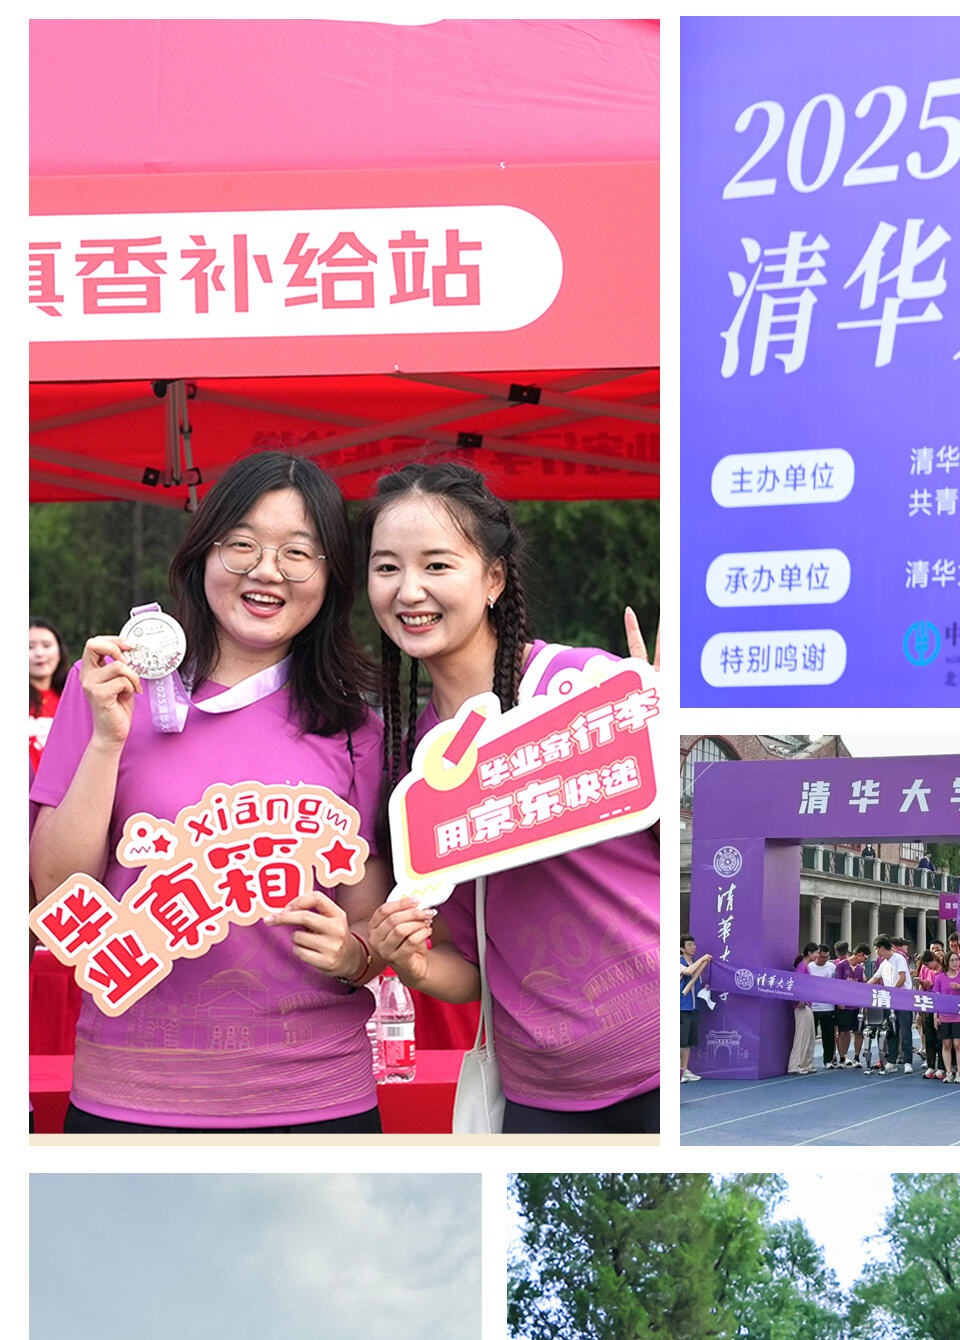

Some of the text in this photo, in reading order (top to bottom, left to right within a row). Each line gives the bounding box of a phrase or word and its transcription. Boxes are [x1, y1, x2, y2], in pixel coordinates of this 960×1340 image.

[730, 462, 835, 495] 主办单位
[724, 562, 831, 595] 承办单位
[720, 643, 827, 675] 特别鸣谢
[481, 688, 661, 787] 毕业寄行李
[436, 759, 641, 856] 用京东快递
